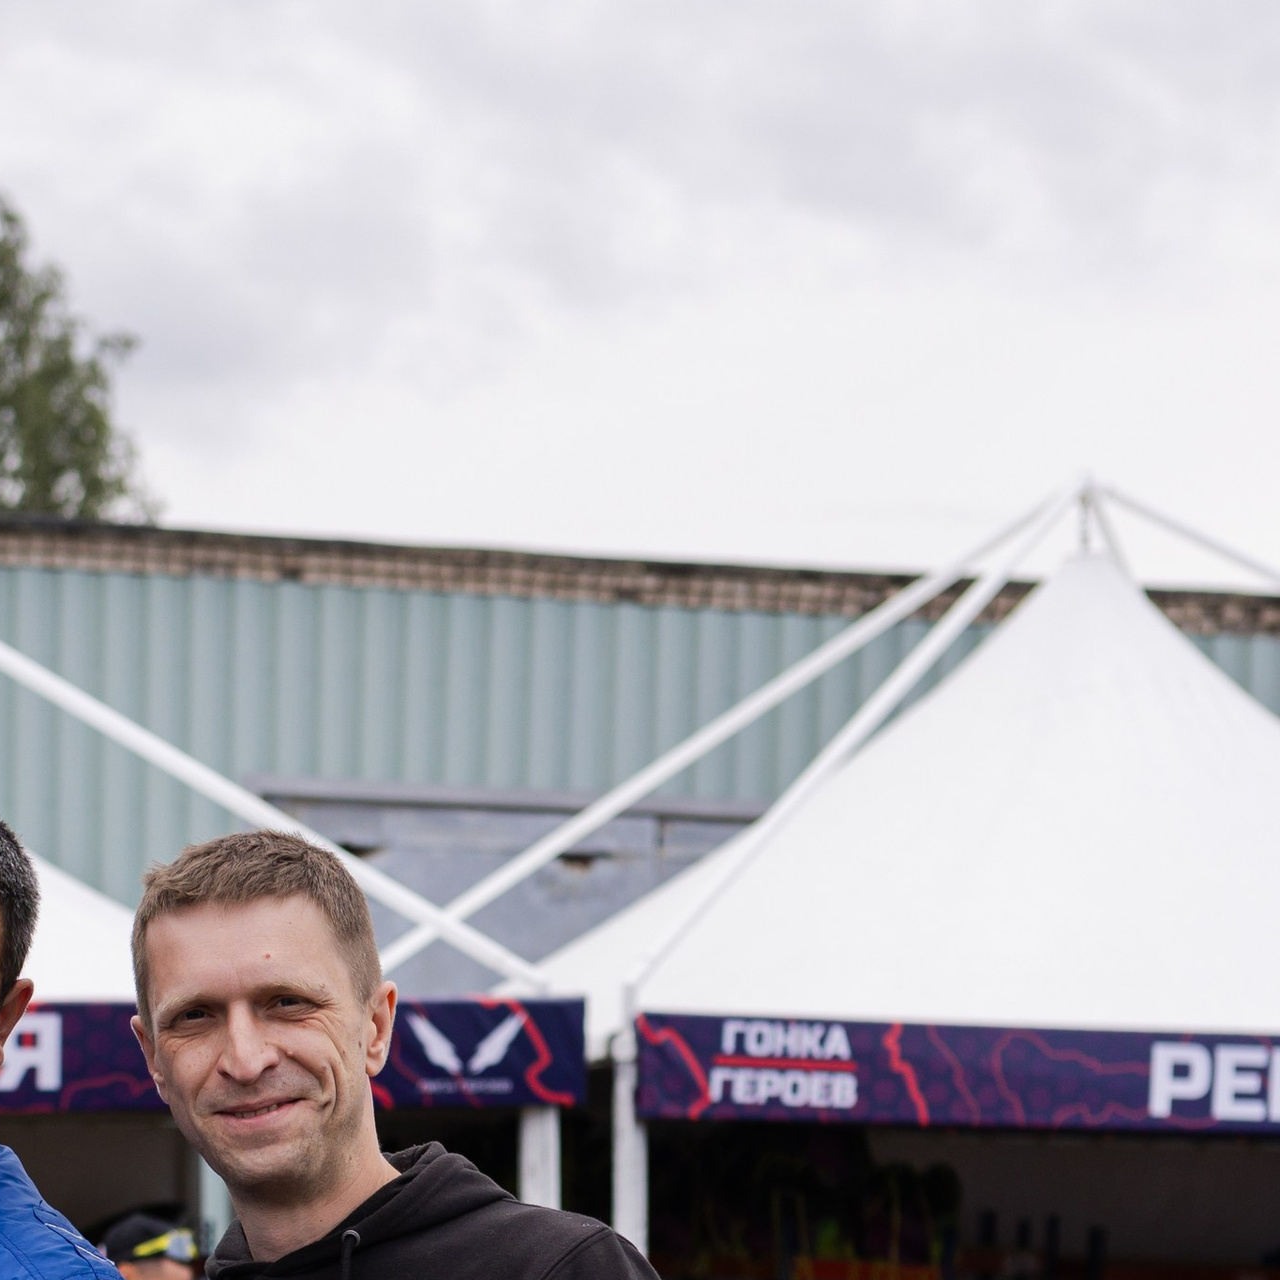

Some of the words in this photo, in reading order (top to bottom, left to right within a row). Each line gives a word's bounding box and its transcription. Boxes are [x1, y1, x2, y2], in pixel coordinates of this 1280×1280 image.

[721, 1018, 853, 1060] ГОНКА
[709, 1065, 859, 1110] ГЕРОЕВ
[1148, 1040, 1280, 1123] РЕ
